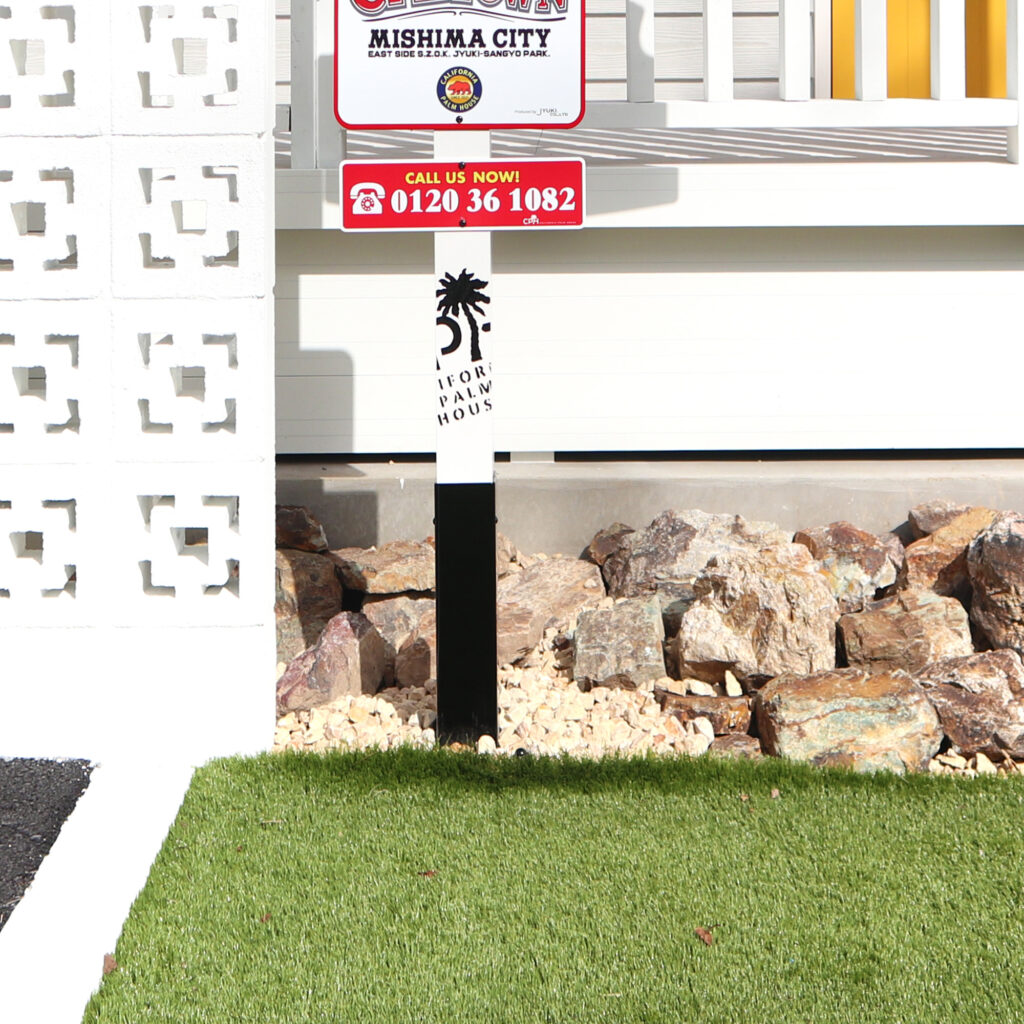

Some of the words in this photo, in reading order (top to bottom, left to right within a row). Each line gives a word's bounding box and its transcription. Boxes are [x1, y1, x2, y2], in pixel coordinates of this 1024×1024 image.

[368, 29, 486, 49] MISHIMA
[492, 29, 551, 49] CITY
[440, 69, 479, 85] CALIFORNIA
[440, 96, 457, 111] PALM
[459, 95, 479, 111] HOUSE
[405, 172, 441, 185] CALL
[445, 172, 466, 184] US
[473, 171, 520, 184] NOW!
[390, 189, 460, 214] 0120
[467, 188, 501, 213] 36
[508, 187, 576, 212] 1082
